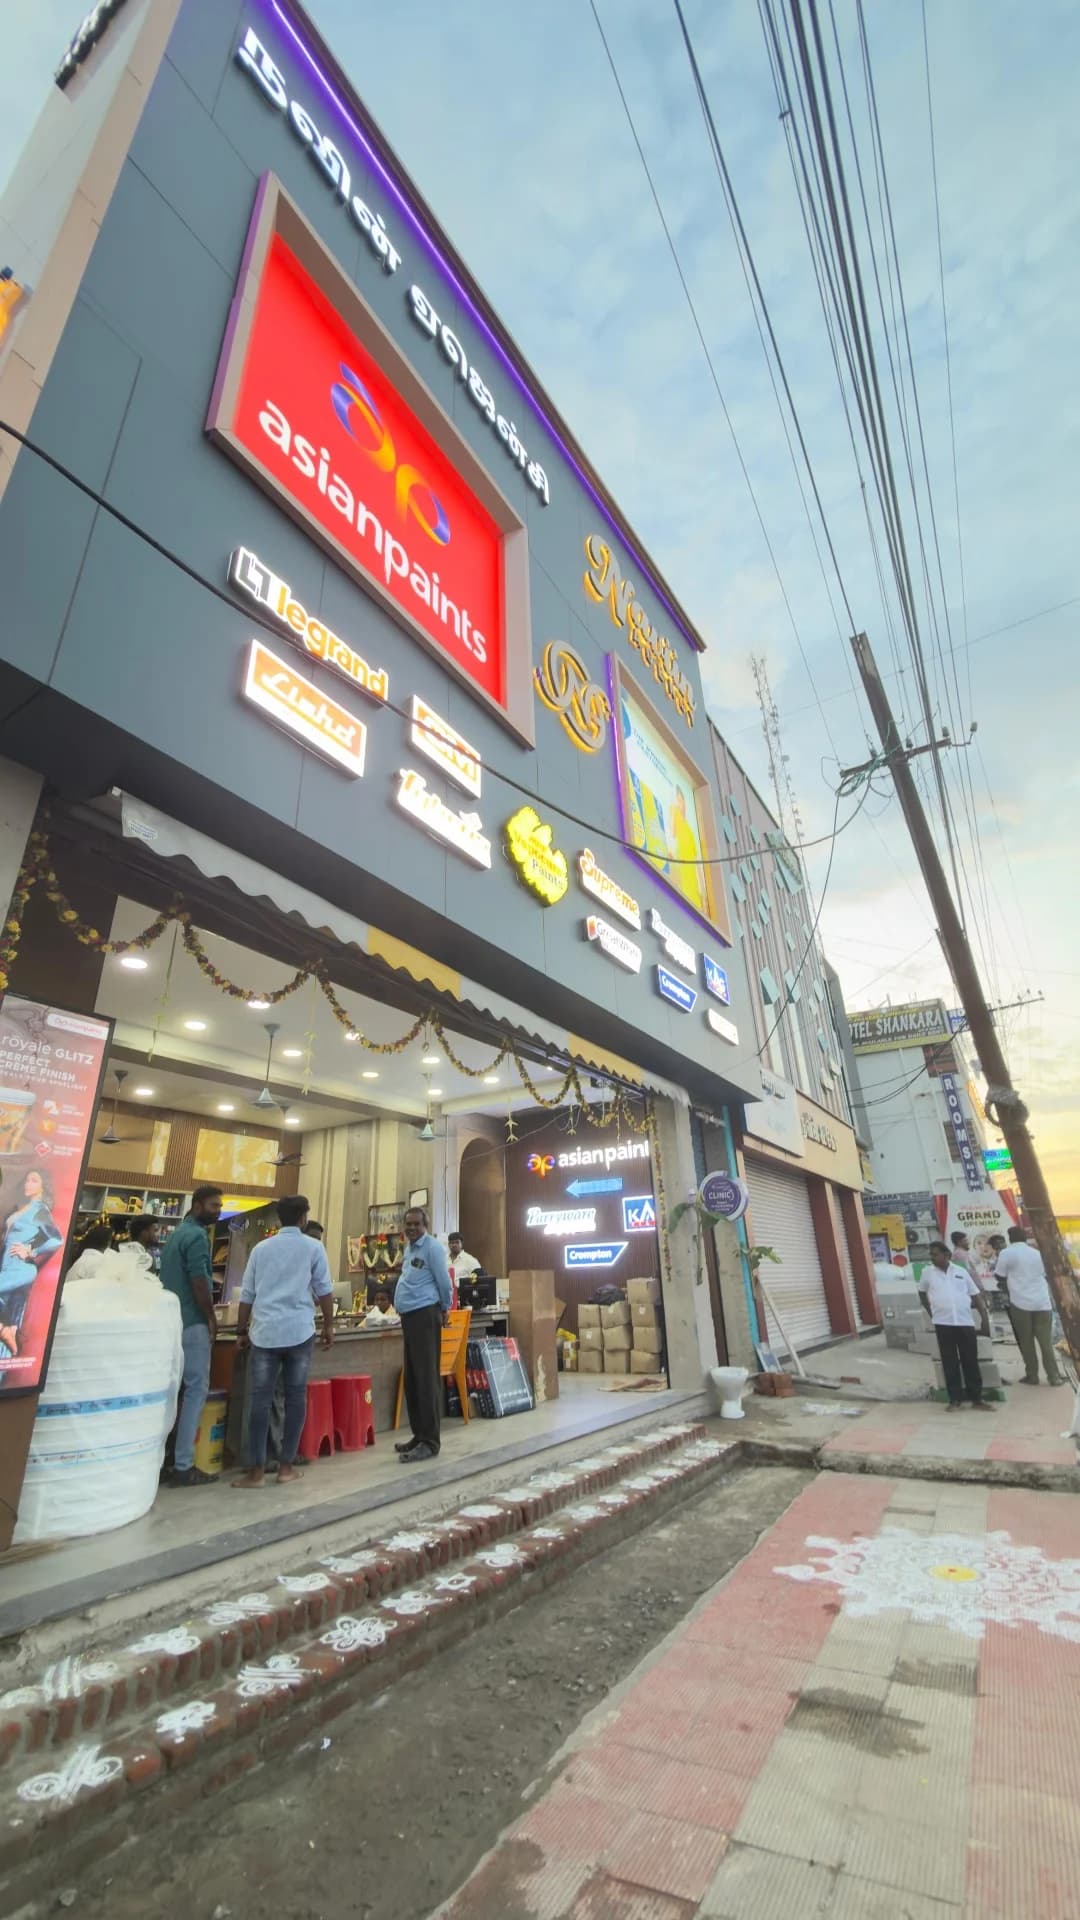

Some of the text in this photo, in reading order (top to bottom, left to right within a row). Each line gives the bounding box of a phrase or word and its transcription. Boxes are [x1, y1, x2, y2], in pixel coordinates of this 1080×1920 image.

[410, 284, 549, 505] ஏஜென்சி
[258, 399, 488, 663] asianpaints
[277, 586, 388, 700] legrand
[581, 849, 638, 913] Supreme
[875, 1008, 942, 1036] SHANKARA
[0, 1050, 50, 1068] PERFECT
[55, 1048, 95, 1065] GLITZ
[40, 1067, 76, 1082] FINISH
[943, 1078, 972, 1160] ROOMS
[627, 1199, 656, 1222] KA
[957, 1209, 1001, 1221] GRAND
[569, 1249, 613, 1261] Crompton
